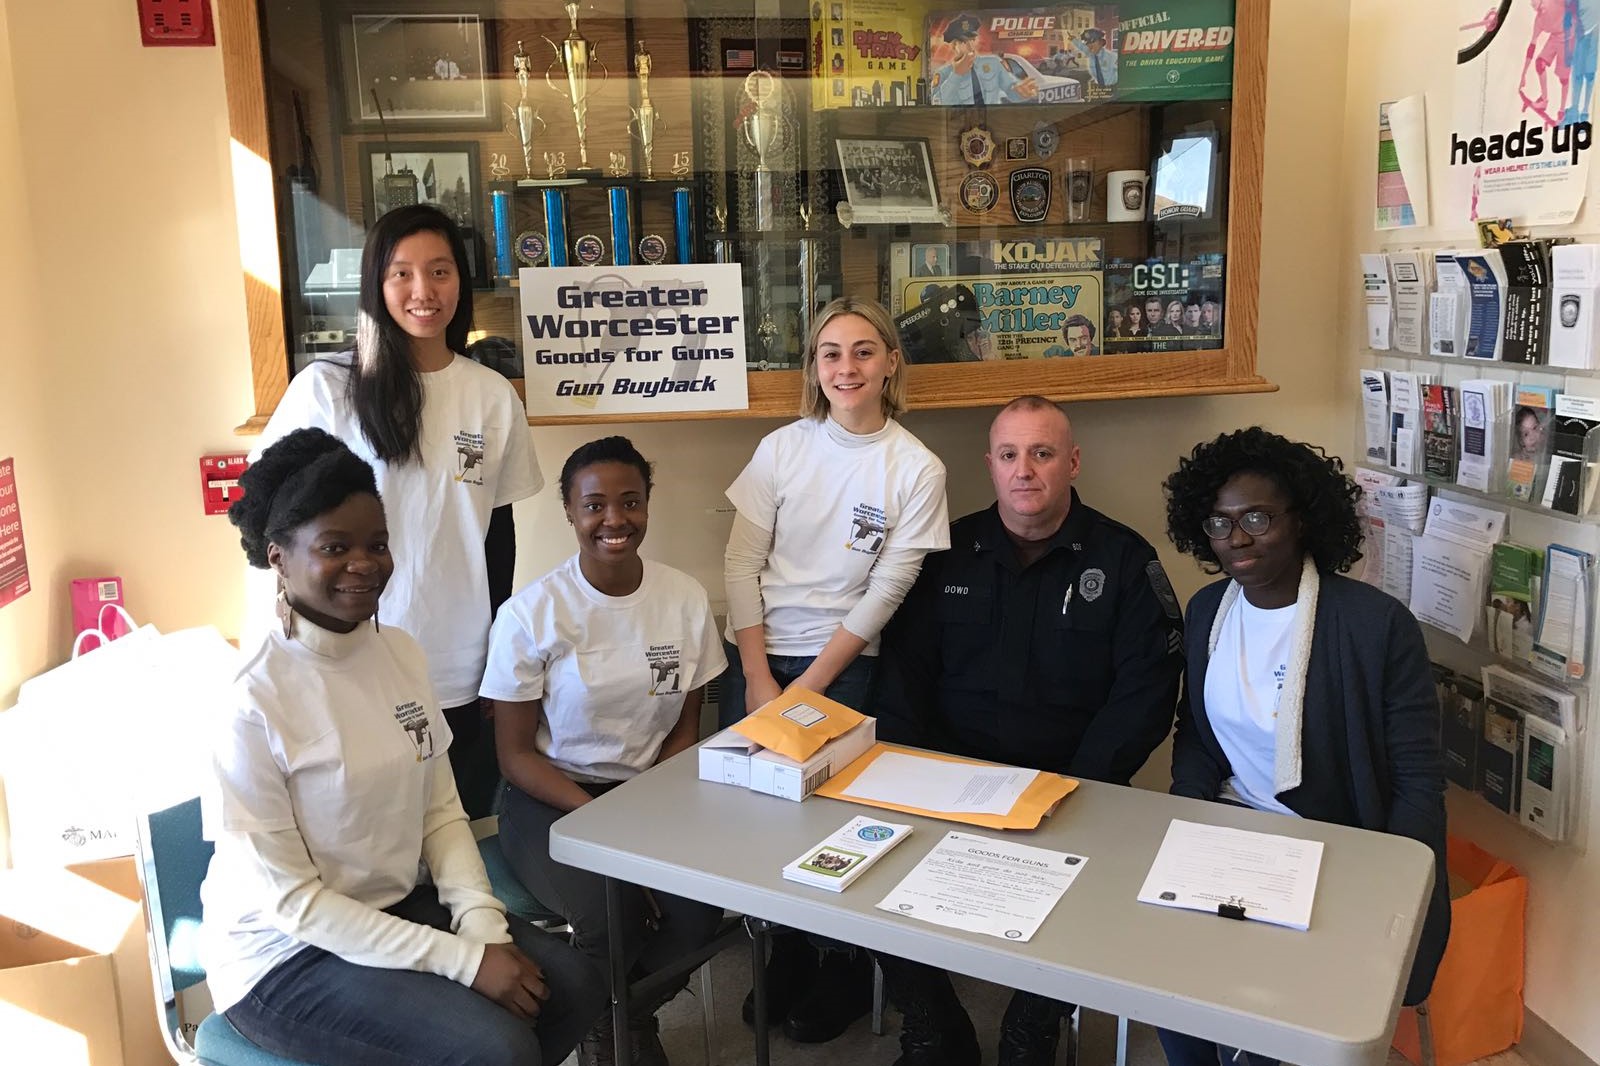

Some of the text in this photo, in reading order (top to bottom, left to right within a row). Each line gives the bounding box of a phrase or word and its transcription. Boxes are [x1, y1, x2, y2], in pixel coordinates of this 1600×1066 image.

[990, 16, 1056, 31] POLICE
[1117, 11, 1171, 32] OFFICIAL
[853, 29, 902, 46] DICK
[858, 42, 921, 61] TRACY
[1165, 57, 1203, 65] EDUCATION
[1205, 55, 1225, 63] GAME
[867, 61, 907, 71] GAME
[1040, 85, 1077, 101] POLICE
[1450, 120, 1593, 166] heads up
[672, 151, 690, 169] 15
[1484, 165, 1501, 175] WEAR
[1541, 161, 1552, 169] THE
[1553, 160, 1568, 168] LAW
[1013, 172, 1050, 182] CHARLTON
[993, 240, 1101, 264] KOJAK
[1133, 263, 1189, 289] CSI:
[557, 285, 708, 309] Greater
[972, 283, 1081, 308] Barney
[527, 314, 739, 339] Worcester
[980, 307, 1066, 334] Miller
[1015, 336, 1057, 345] PRECINCT
[535, 345, 734, 365] Goods for Guns
[556, 375, 717, 397] Gun Buyback
[968, 848, 1000, 859] GOODS
[1022, 859, 1049, 868] GUNS
